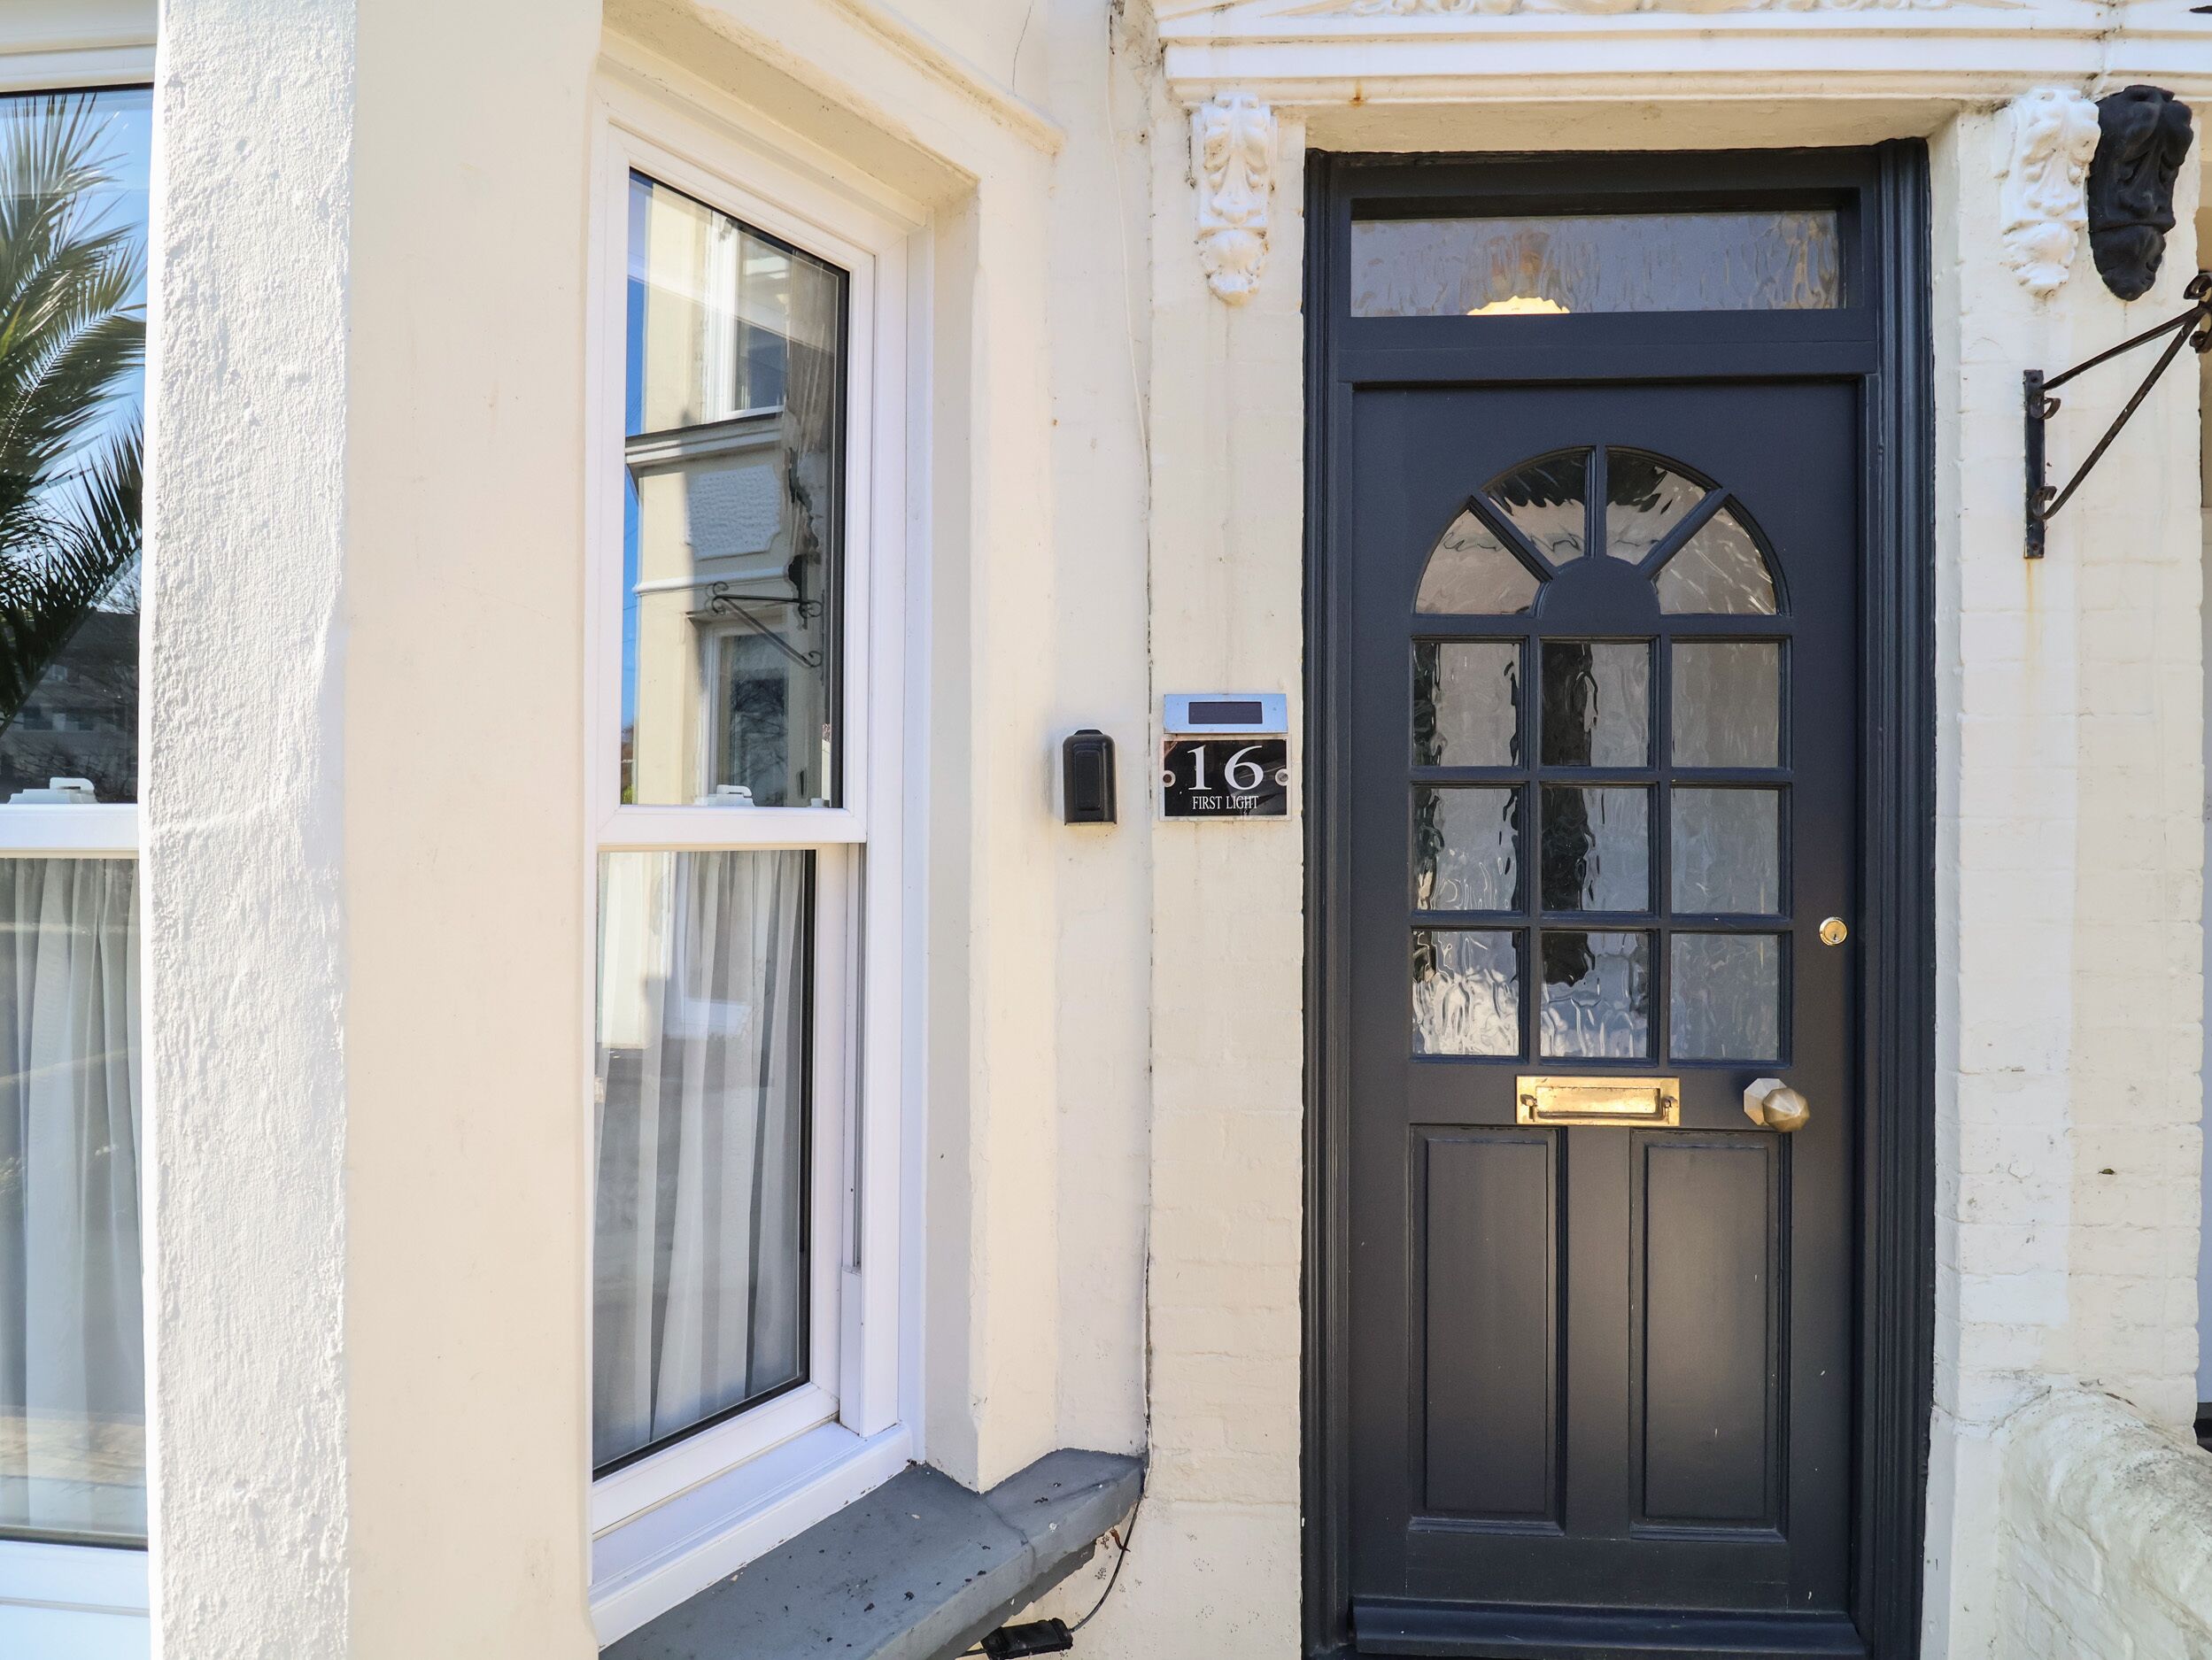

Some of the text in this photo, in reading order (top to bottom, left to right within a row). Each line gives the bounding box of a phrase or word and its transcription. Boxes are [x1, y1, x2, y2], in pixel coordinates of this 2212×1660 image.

[1187, 745, 1264, 791] 16
[1193, 795, 1259, 809] FIRST LIGHT
